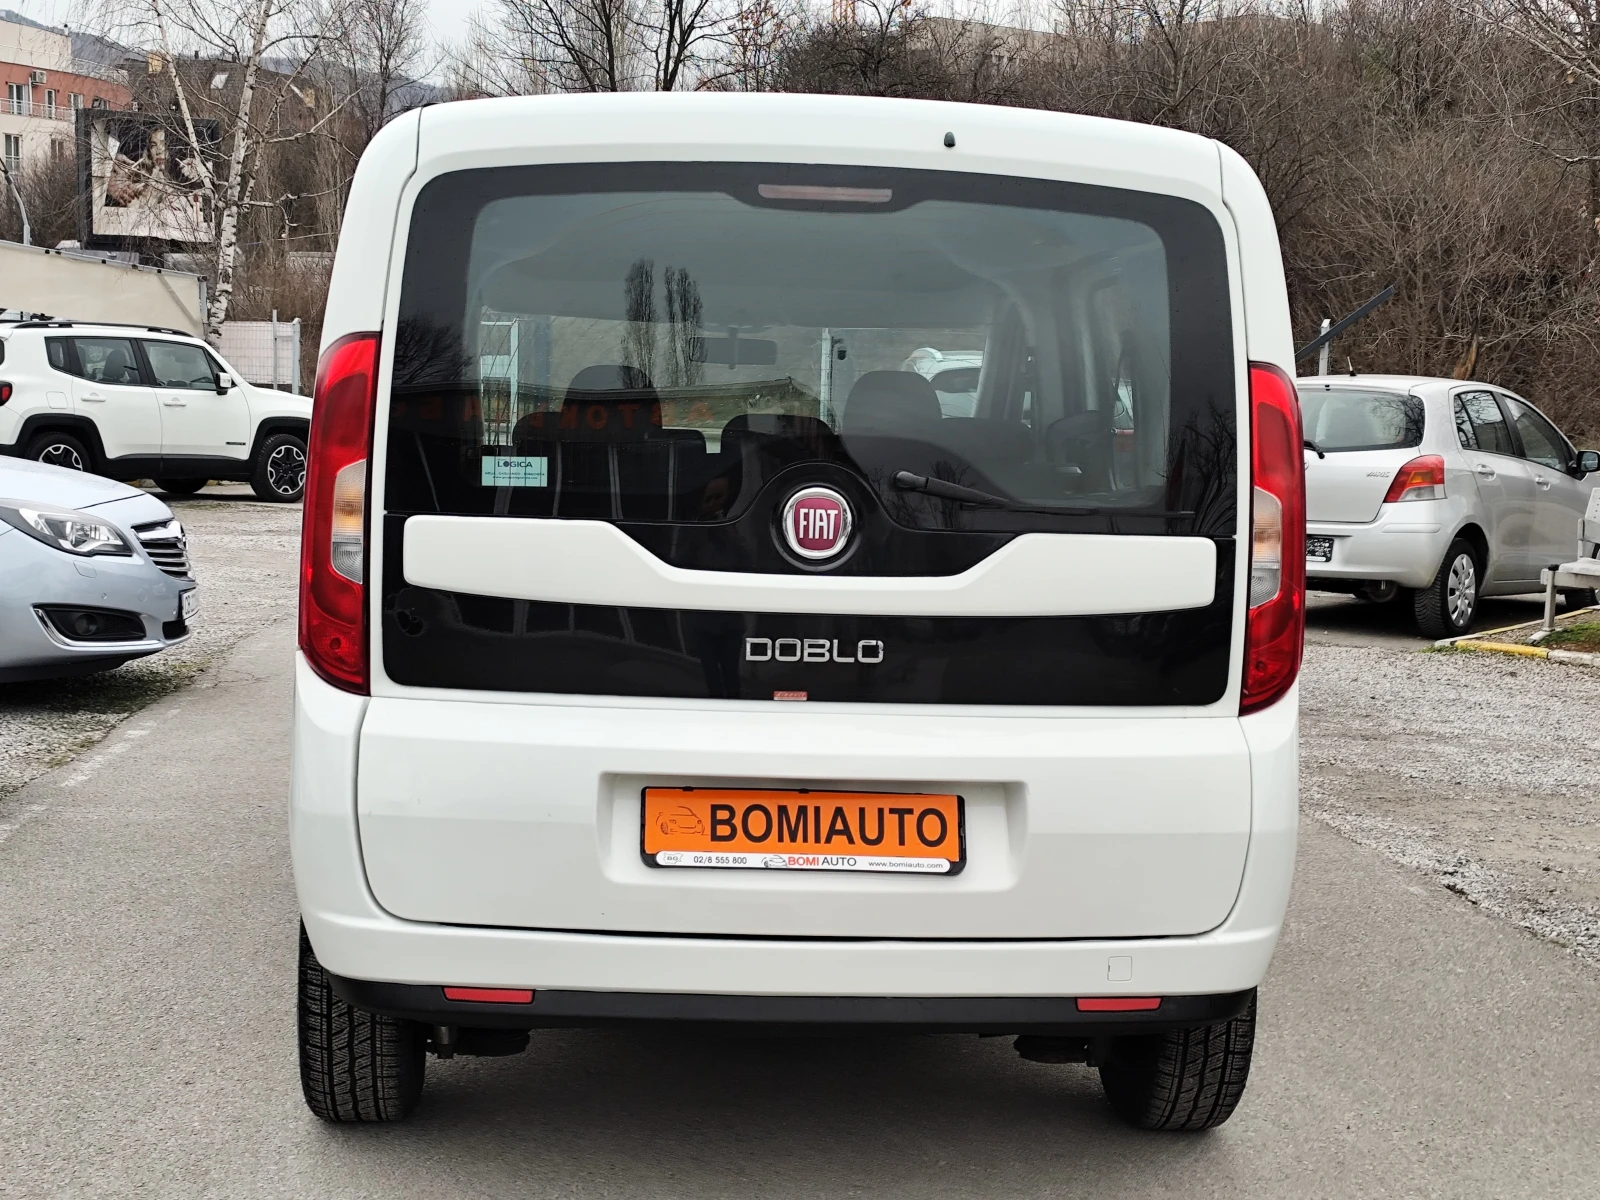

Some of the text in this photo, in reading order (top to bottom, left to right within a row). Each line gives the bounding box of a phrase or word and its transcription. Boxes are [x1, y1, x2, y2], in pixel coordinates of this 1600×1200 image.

[497, 460, 533, 468] LOGICA
[799, 508, 839, 540] FIAT
[745, 637, 884, 664] DOBLO
[710, 804, 948, 847] BOMIAUTO
[693, 855, 748, 865] 02/8 555 800
[787, 856, 857, 867] BOMI AUTO
[868, 860, 943, 869] www.bomiauto.com
